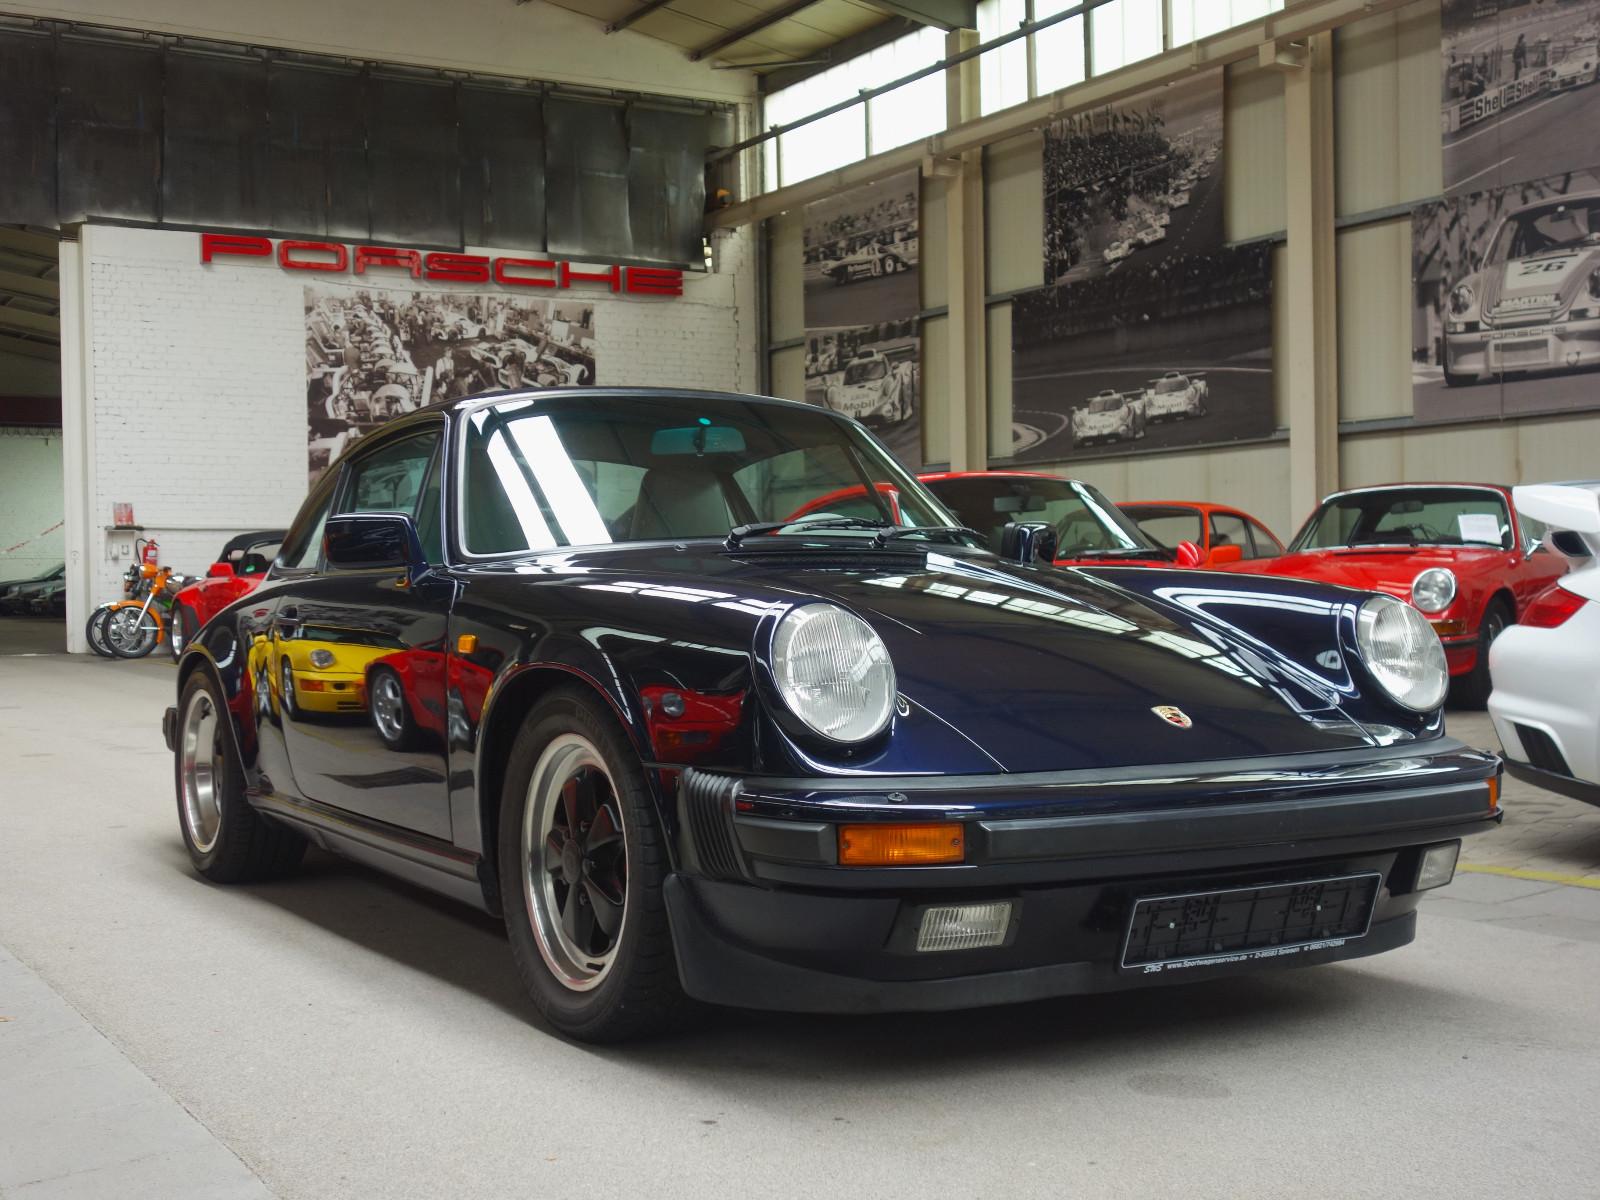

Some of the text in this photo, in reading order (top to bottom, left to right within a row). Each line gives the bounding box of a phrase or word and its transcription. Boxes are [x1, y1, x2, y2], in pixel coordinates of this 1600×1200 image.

[200, 232, 684, 296] PORSCHE
[1518, 260, 1567, 276] 26
[1481, 326, 1567, 341] PORSCHE
[843, 400, 876, 412] Mobil
